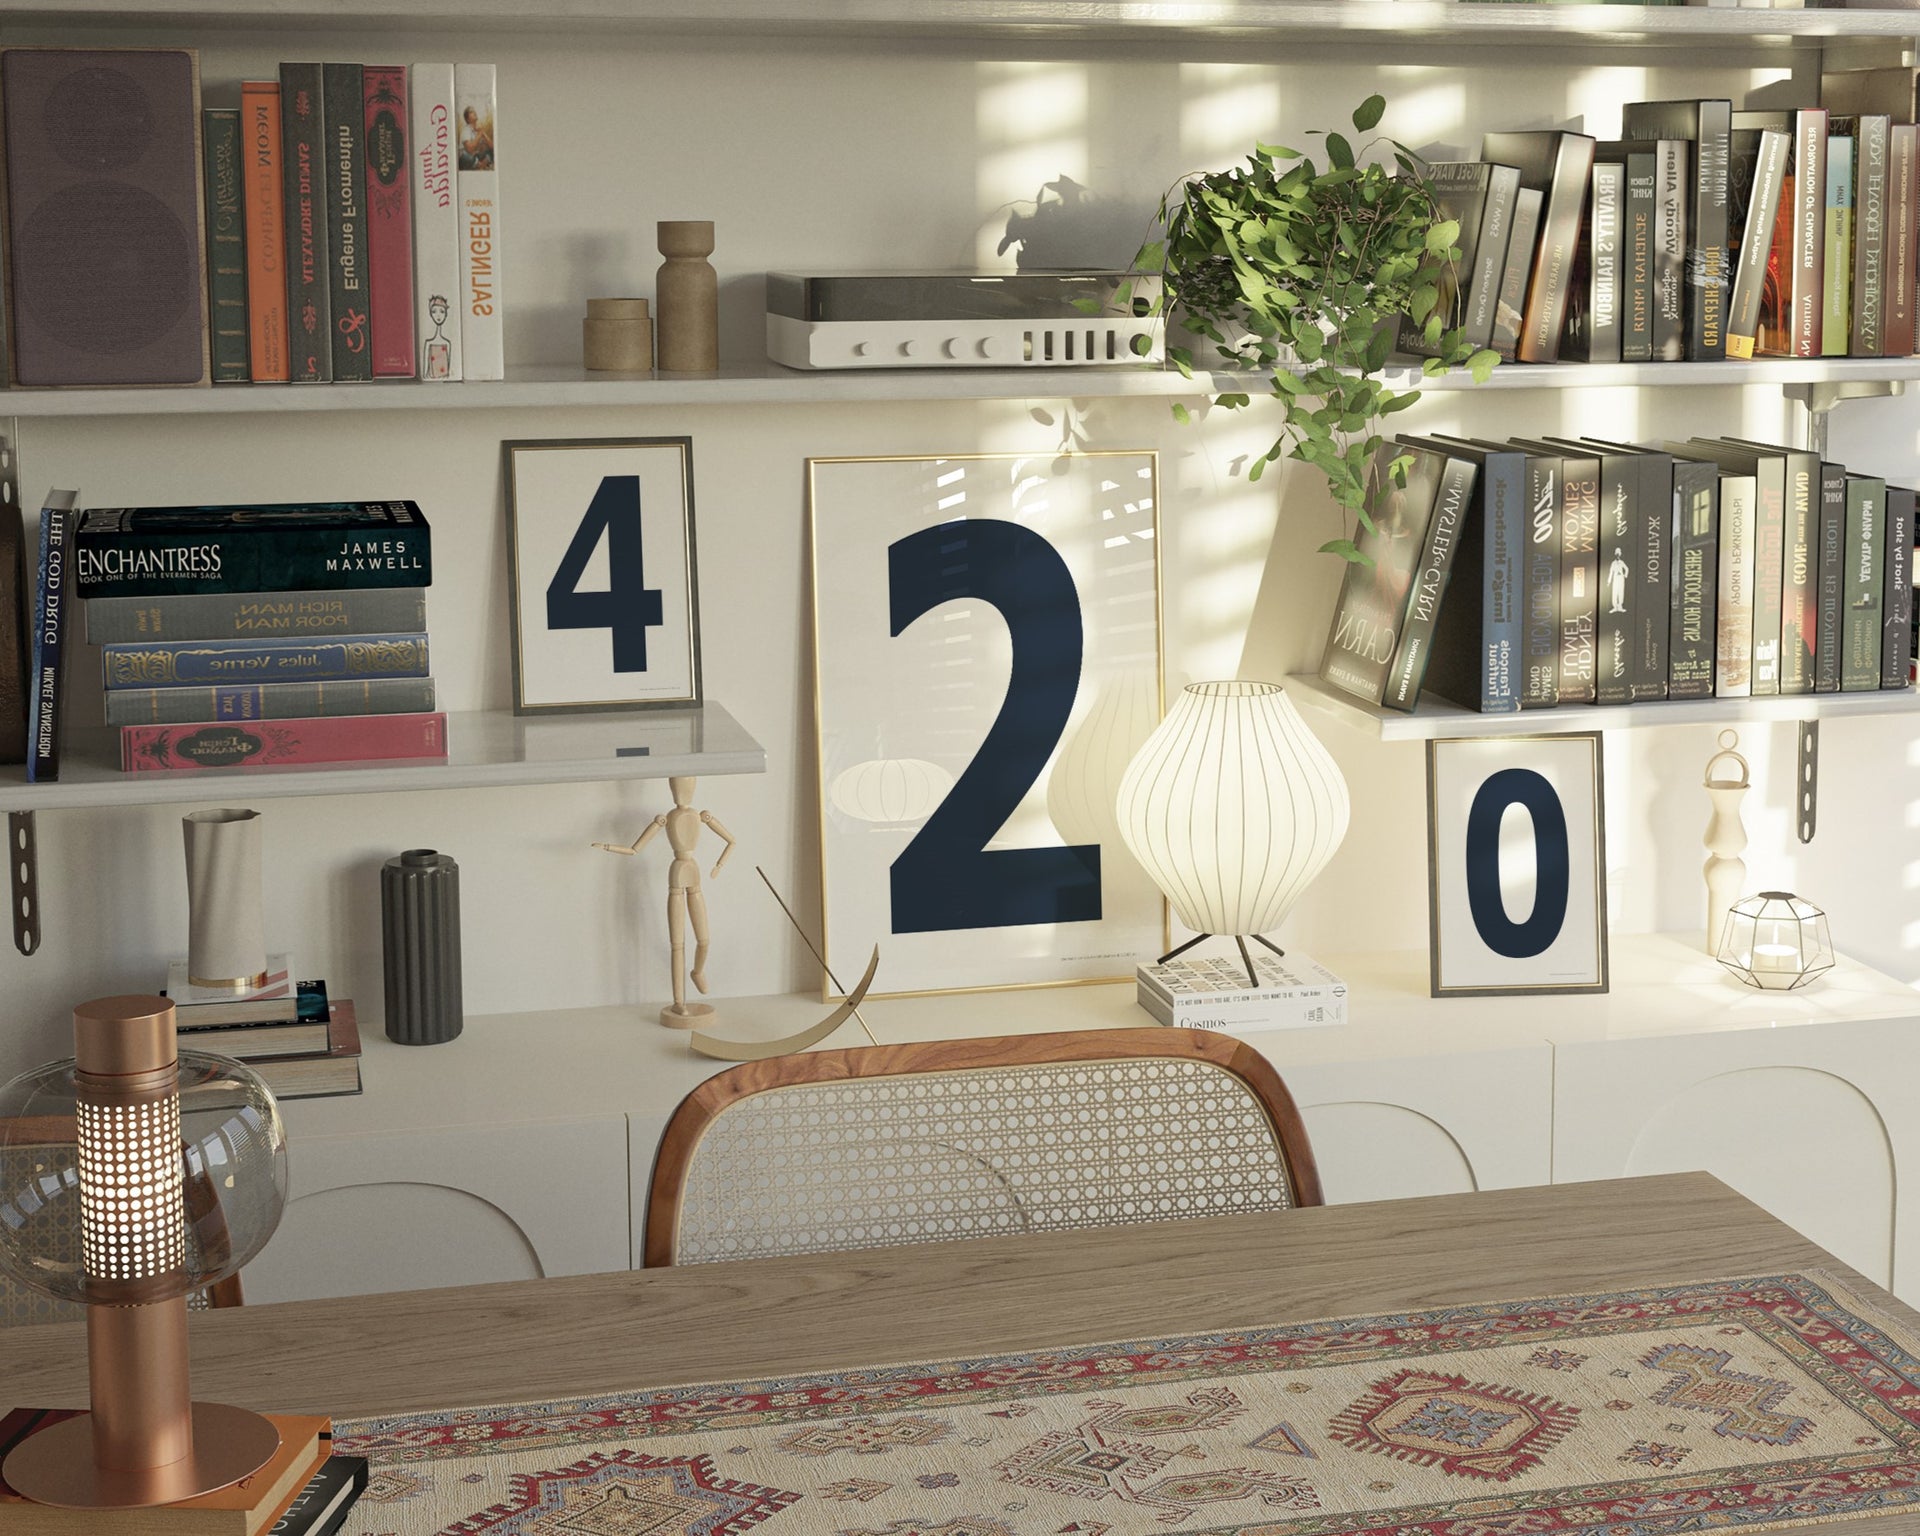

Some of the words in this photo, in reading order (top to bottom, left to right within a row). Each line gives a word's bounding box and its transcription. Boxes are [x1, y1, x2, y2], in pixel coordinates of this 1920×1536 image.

[77, 543, 222, 577] ENCHANTRESS
[325, 556, 423, 572] MAXWELL
[339, 541, 407, 554] JAMES
[547, 475, 663, 673] 4
[888, 518, 1102, 934] 2
[1466, 768, 1569, 959] 0
[1180, 1017, 1226, 1029] Cosmos
